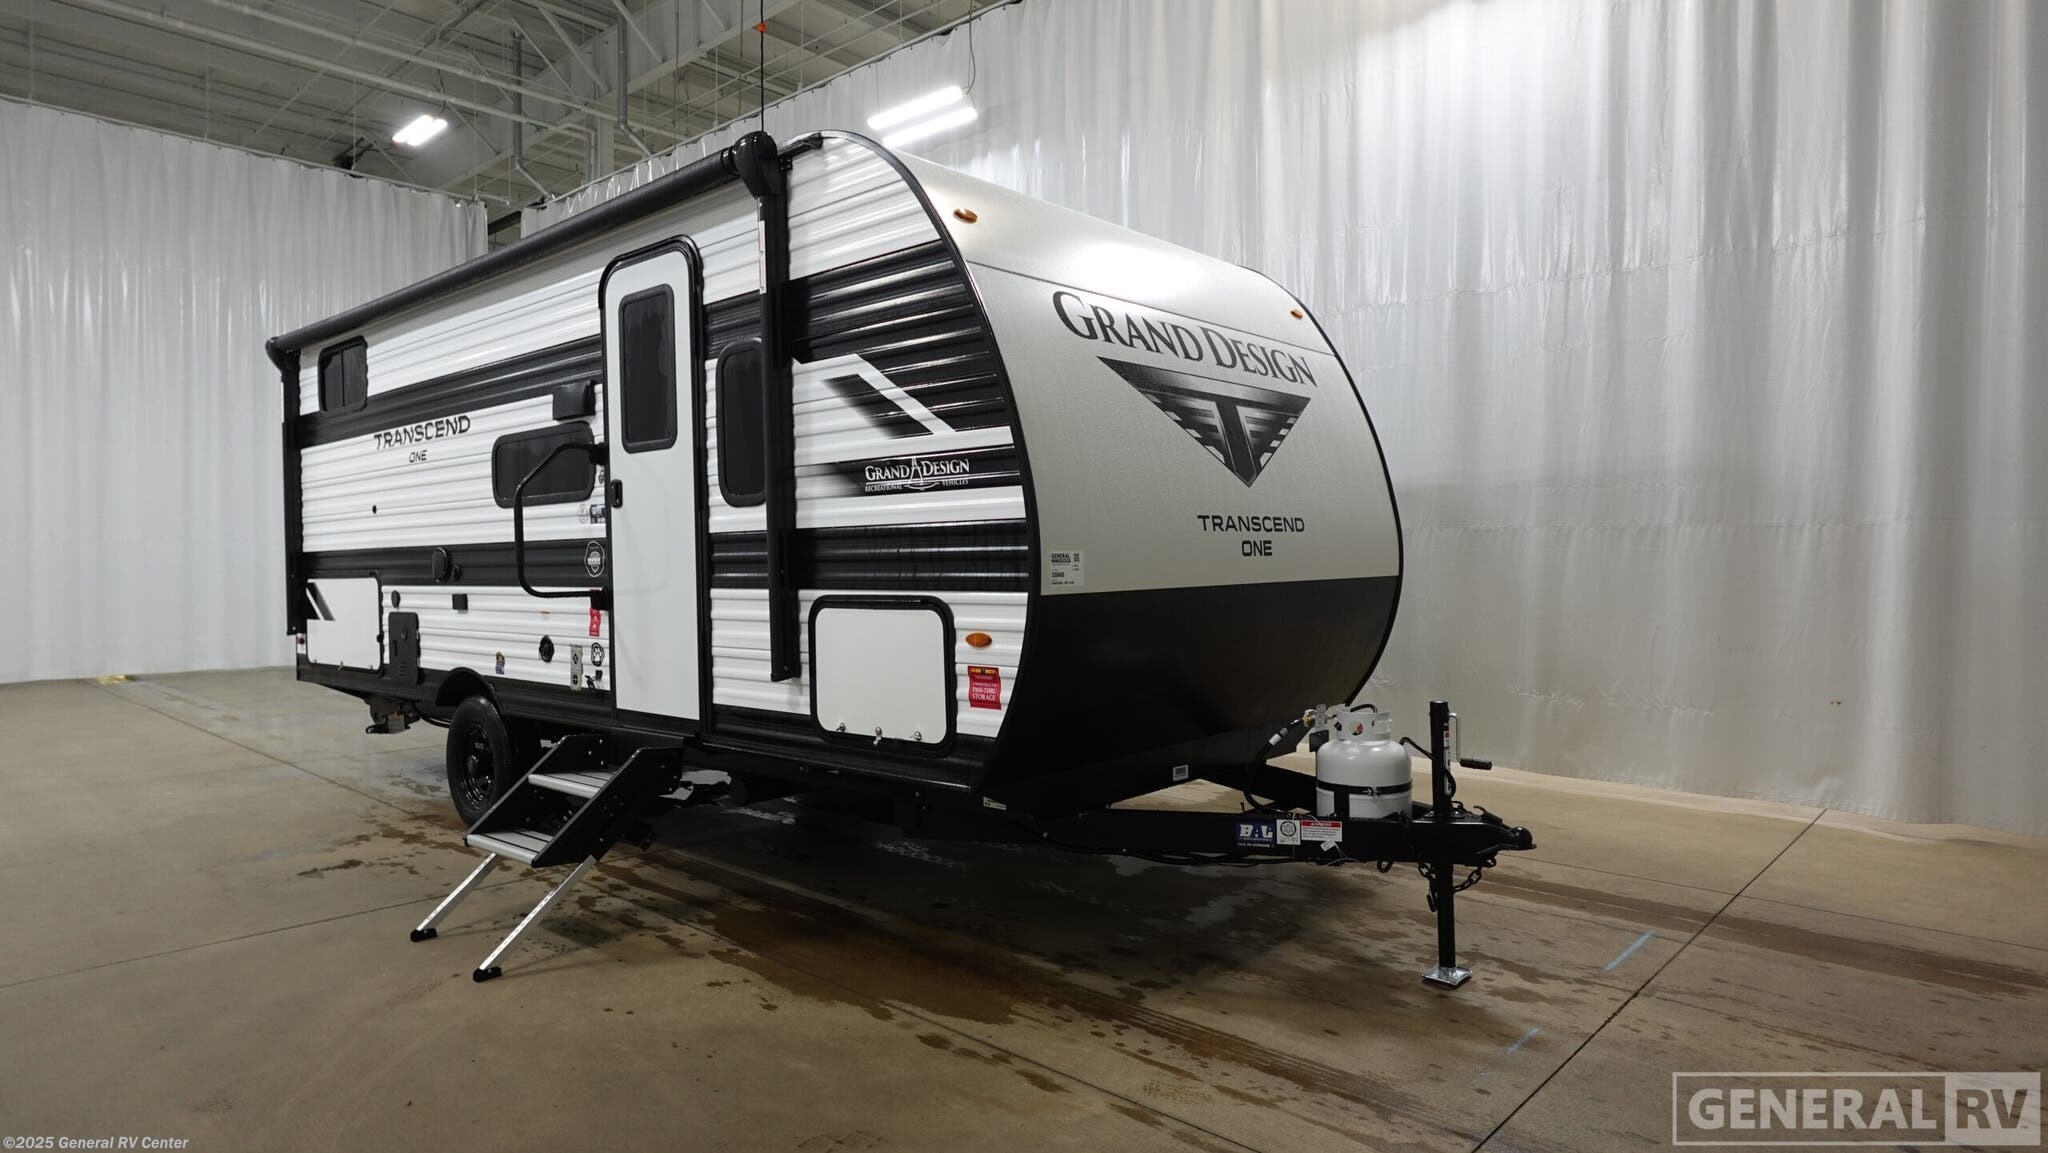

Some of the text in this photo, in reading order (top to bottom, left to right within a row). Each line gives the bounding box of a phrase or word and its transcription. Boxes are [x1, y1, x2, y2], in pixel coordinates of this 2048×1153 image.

[1052, 291, 1318, 388] GRAND DESIGN
[374, 415, 471, 450] TRANSCEND
[409, 449, 427, 463] ONE
[865, 459, 970, 481] GRAND DESIGN
[1197, 515, 1305, 532] TRANSCEND
[1241, 540, 1272, 556] ONE
